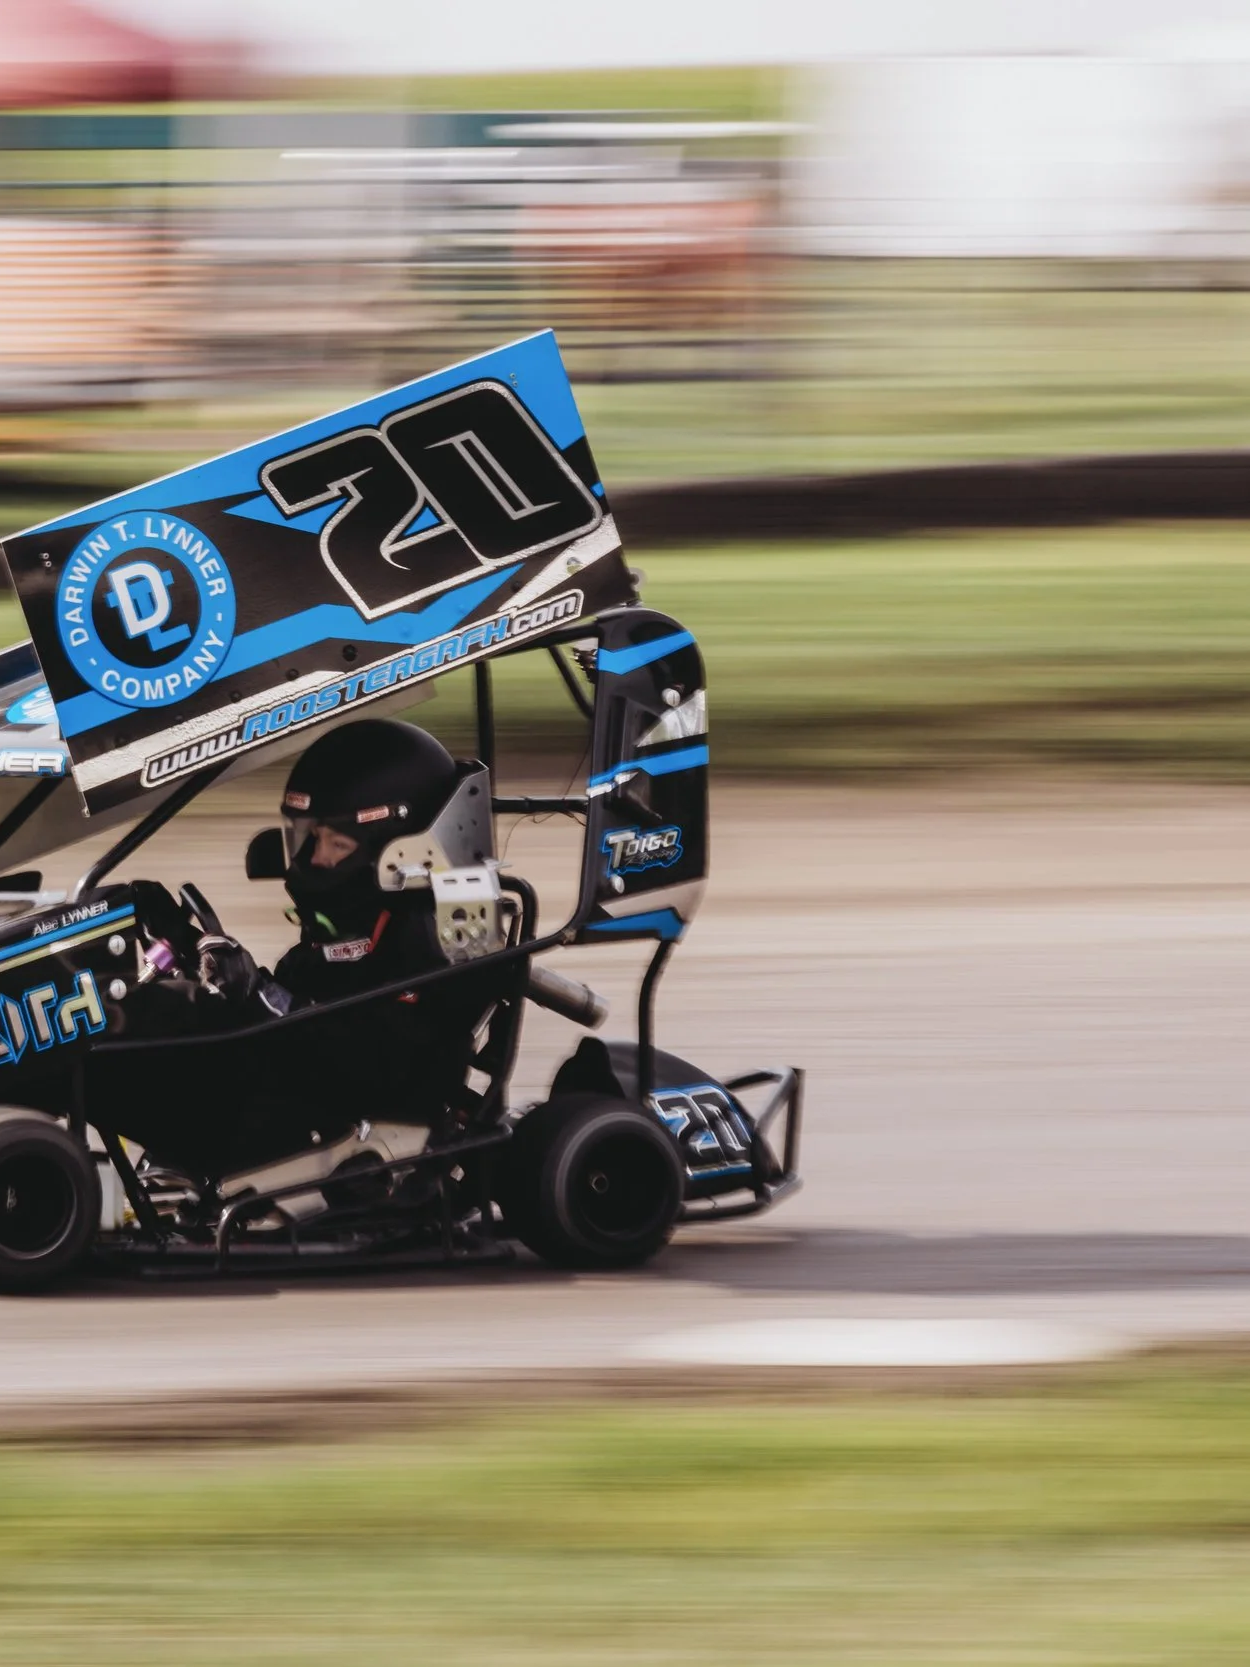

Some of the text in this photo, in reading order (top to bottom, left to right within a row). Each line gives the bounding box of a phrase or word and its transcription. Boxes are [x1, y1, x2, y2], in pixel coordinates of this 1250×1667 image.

[259, 378, 604, 621] 20
[65, 517, 227, 647] DARWIN T. LYNNER
[102, 630, 224, 700] COMPANY
[33, 900, 109, 937] Alec LYNNER
